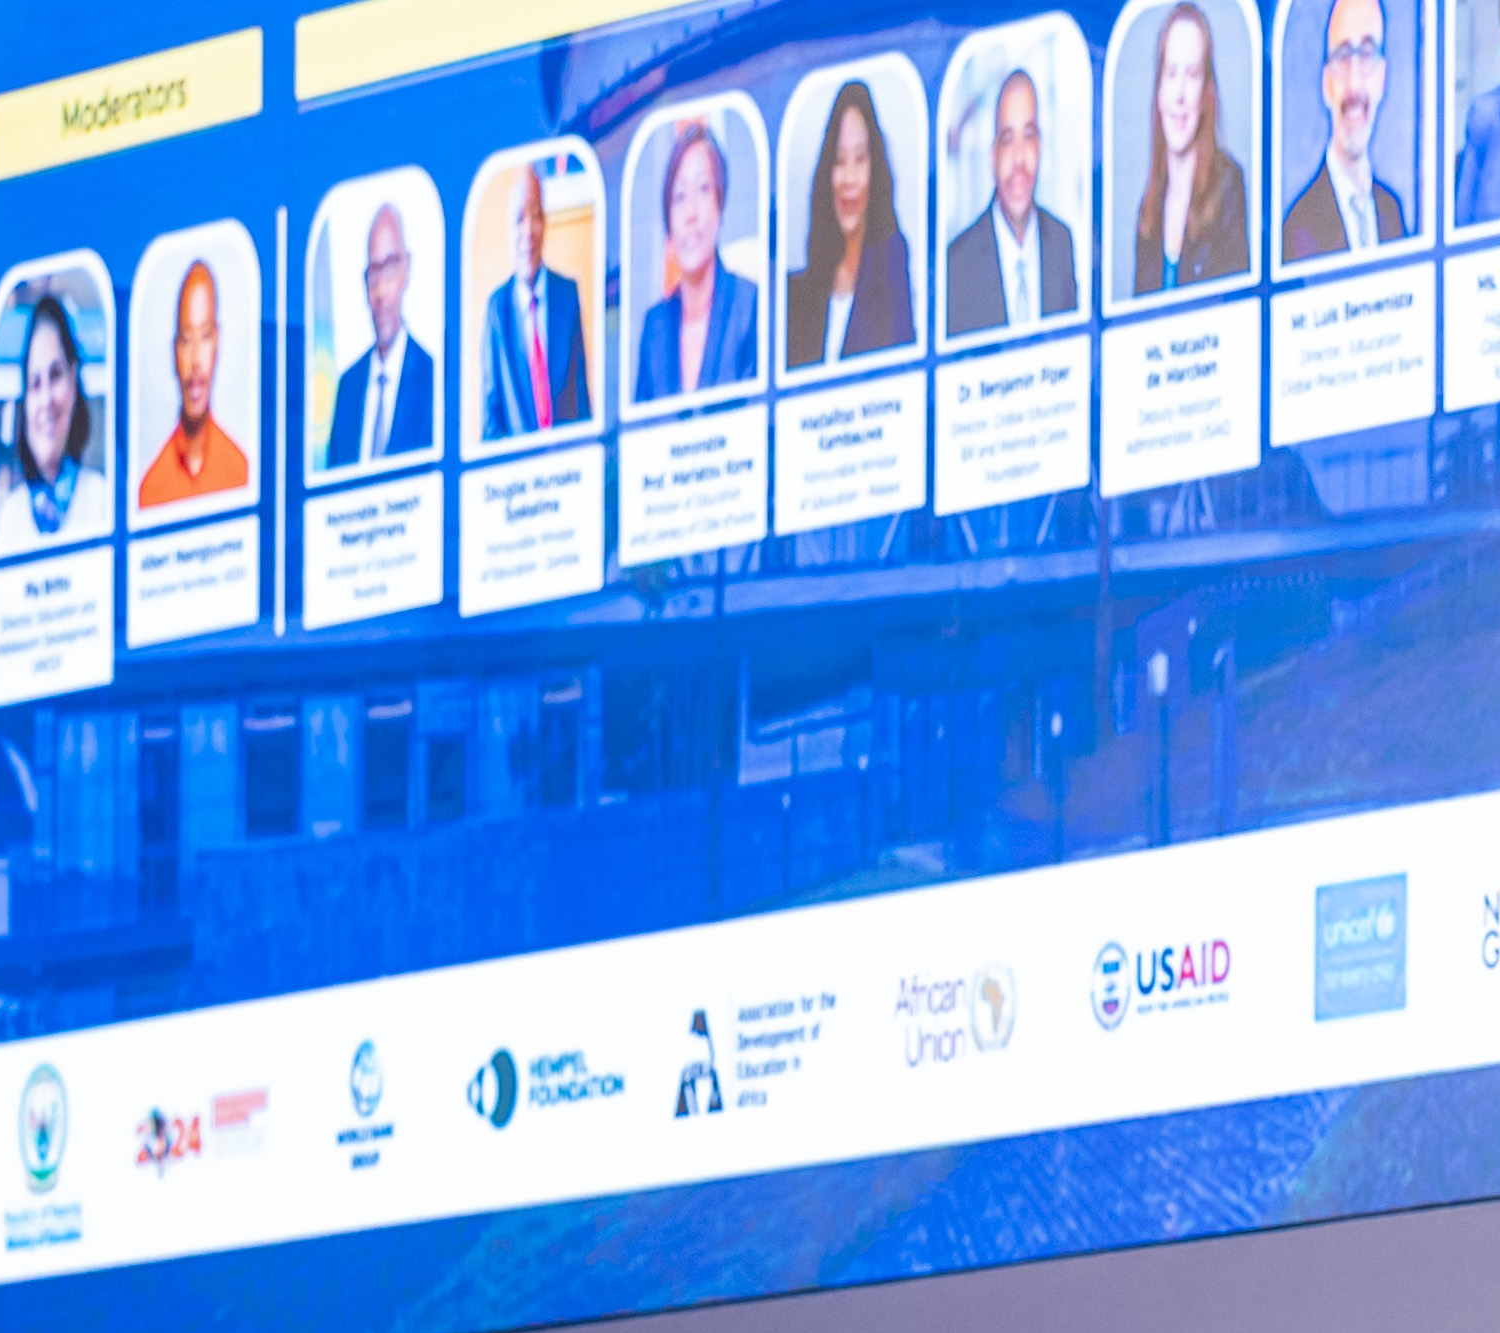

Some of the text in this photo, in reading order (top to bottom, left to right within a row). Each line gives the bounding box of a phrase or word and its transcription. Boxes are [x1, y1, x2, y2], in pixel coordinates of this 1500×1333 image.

[61, 77, 188, 140] Moderators
[1323, 907, 1375, 948] unicef
[1137, 939, 1230, 995] USAID
[895, 974, 966, 1017] African
[529, 1050, 588, 1079] HEMPEL
[906, 1026, 966, 1068] Union
[529, 1074, 625, 1108] FOUNDATION
